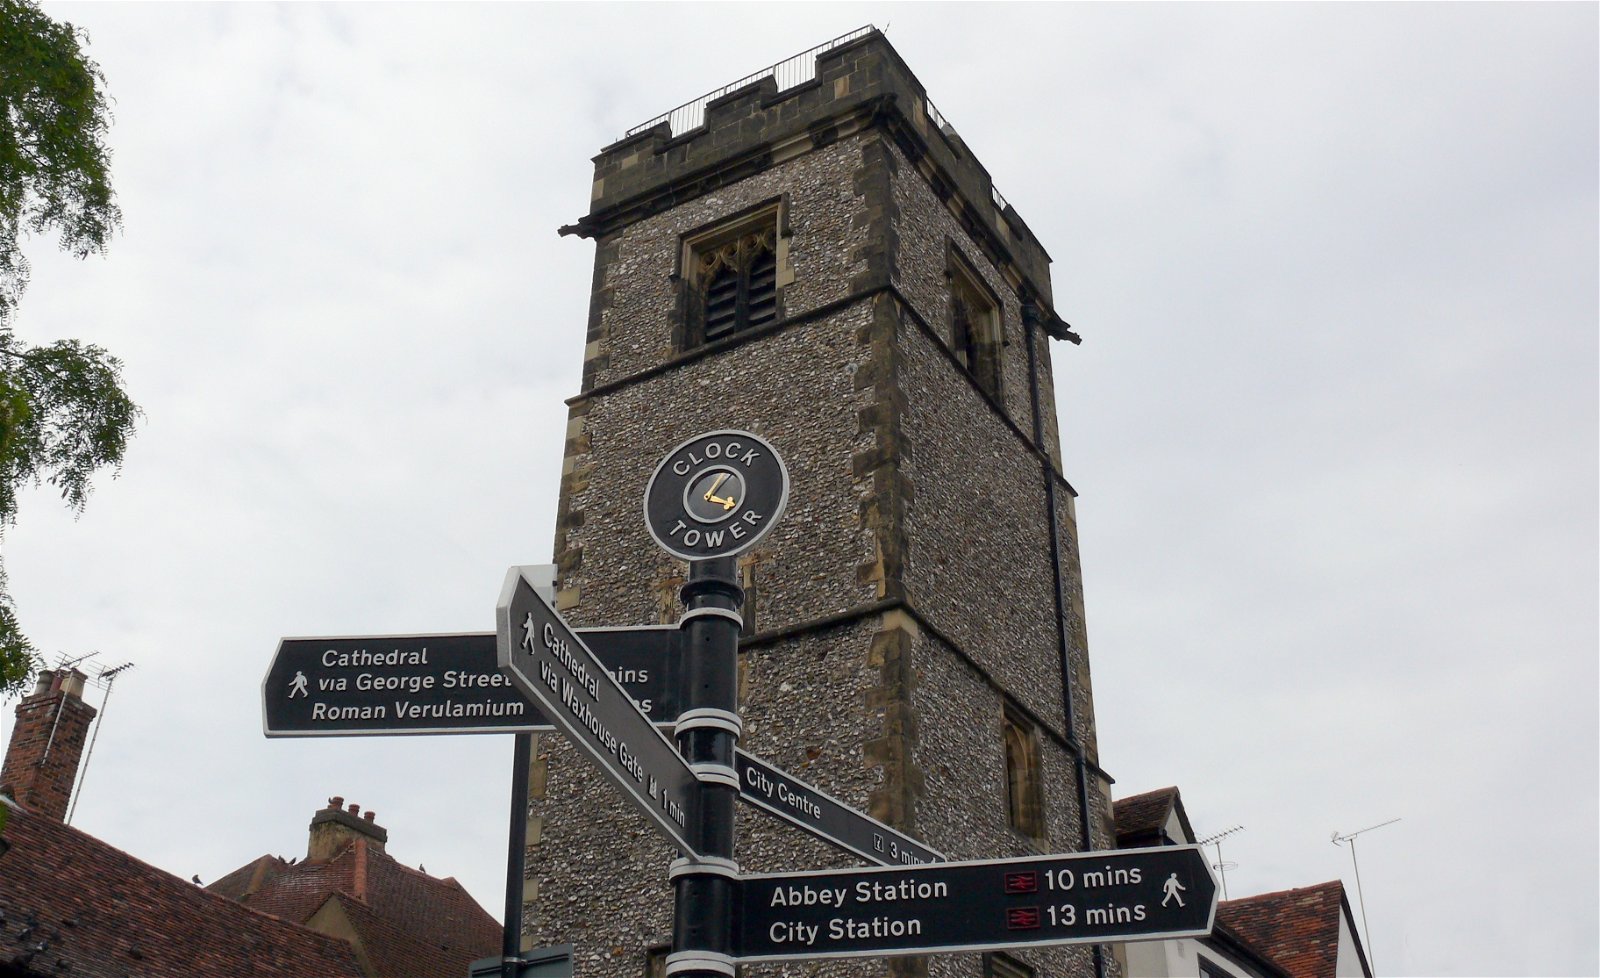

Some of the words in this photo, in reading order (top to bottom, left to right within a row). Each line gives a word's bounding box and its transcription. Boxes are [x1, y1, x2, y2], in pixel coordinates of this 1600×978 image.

[673, 442, 760, 475] CLOCK
[669, 510, 762, 547] TOWER
[321, 648, 428, 667] Cathedral
[543, 622, 599, 702] Cathedral
[318, 677, 347, 691] via
[355, 673, 435, 692] George
[442, 671, 512, 688] Street
[312, 702, 386, 720] Roman
[395, 699, 524, 718] Verulamium
[541, 660, 558, 693] via
[562, 677, 617, 754] Waxhouse
[619, 742, 643, 783] Gate
[669, 800, 685, 827] min
[746, 766, 774, 797] City
[778, 783, 821, 819] Centre
[890, 841, 898, 858] 3
[770, 885, 847, 908] Abbey
[855, 879, 948, 902] Station
[1045, 869, 1075, 890] 10
[1083, 865, 1142, 888] mins
[769, 921, 819, 945] City
[828, 916, 921, 939] Station
[1047, 904, 1076, 926] 13
[1086, 903, 1146, 925] mins
